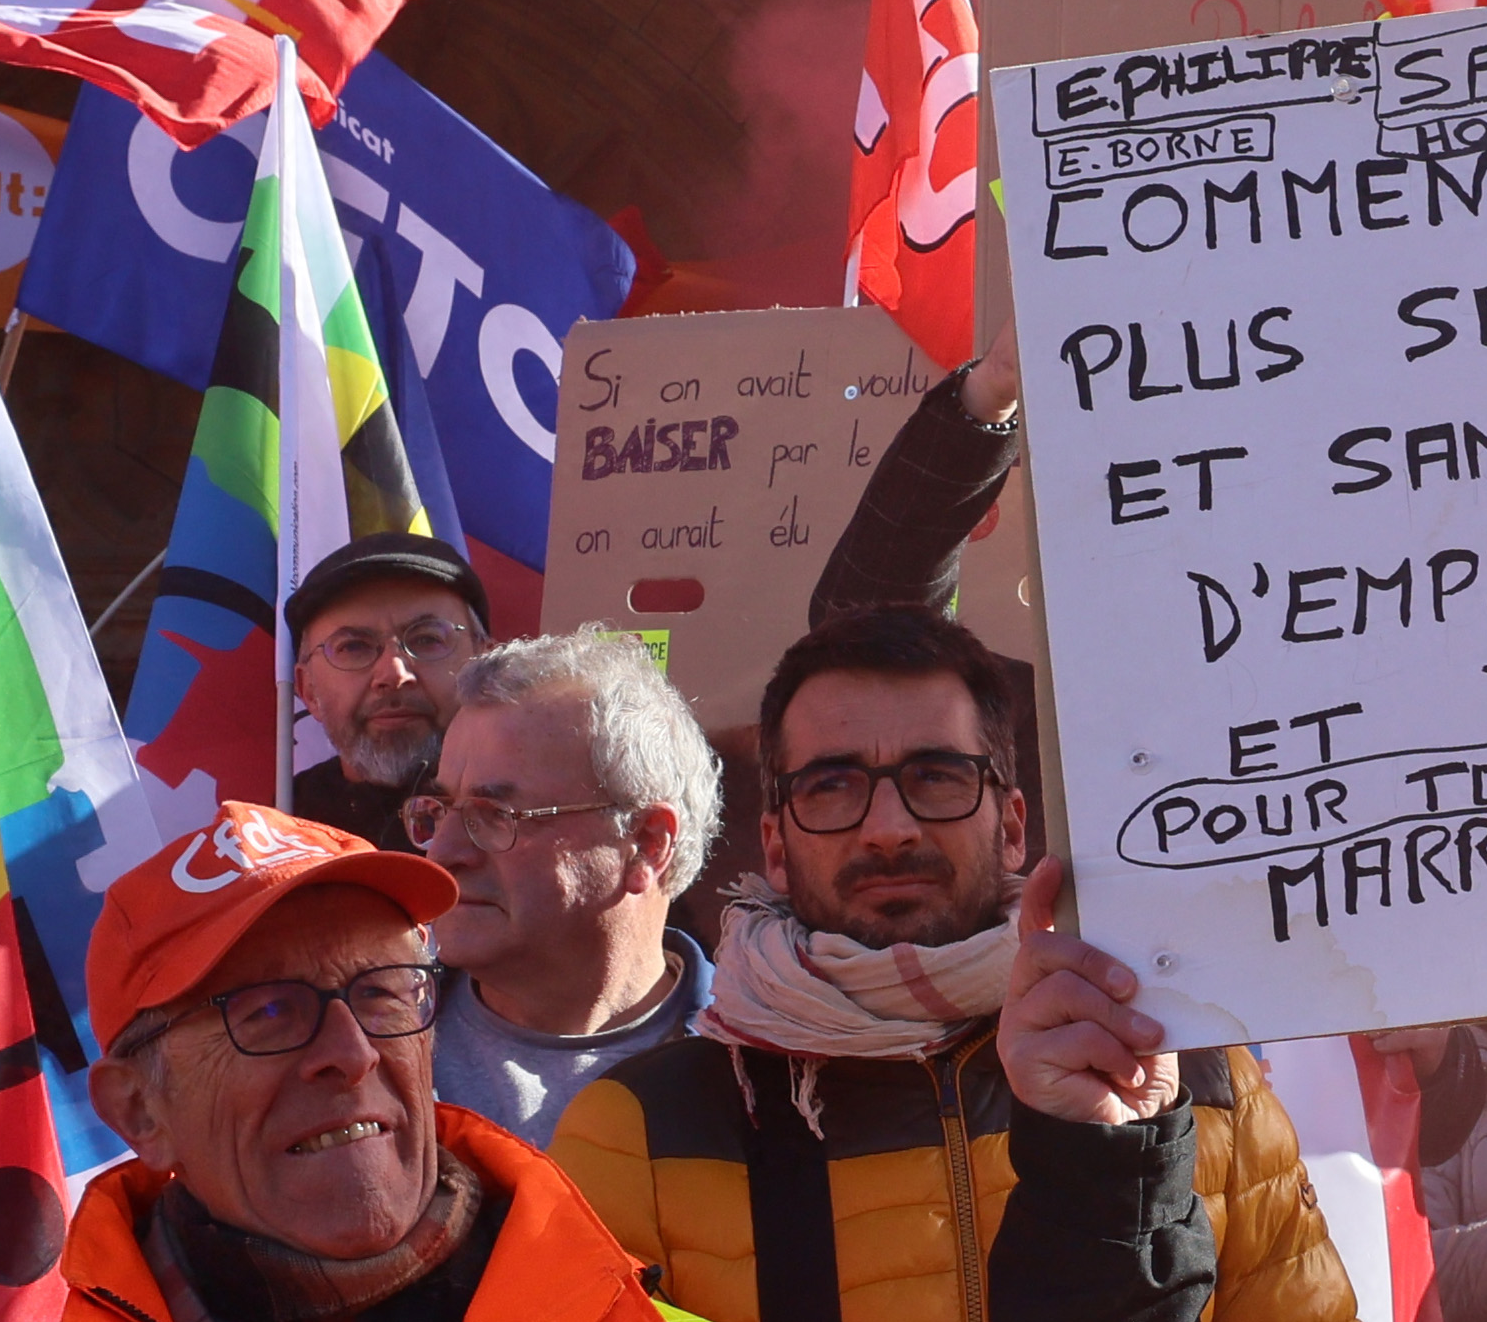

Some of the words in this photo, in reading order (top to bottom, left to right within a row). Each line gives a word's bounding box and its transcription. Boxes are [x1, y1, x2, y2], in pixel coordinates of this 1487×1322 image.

[579, 349, 622, 411] Si
[660, 378, 700, 404] on
[737, 349, 812, 399] avait
[857, 346, 929, 398] voulu
[1059, 307, 1308, 412] PLUS
[768, 441, 818, 488] par
[848, 419, 872, 467] le
[1107, 445, 1250, 527] ET
[576, 527, 610, 555] on
[641, 505, 724, 550] aurait
[770, 495, 810, 548] élu
[1228, 704, 1364, 775] ET
[1151, 784, 1351, 854] POUR
